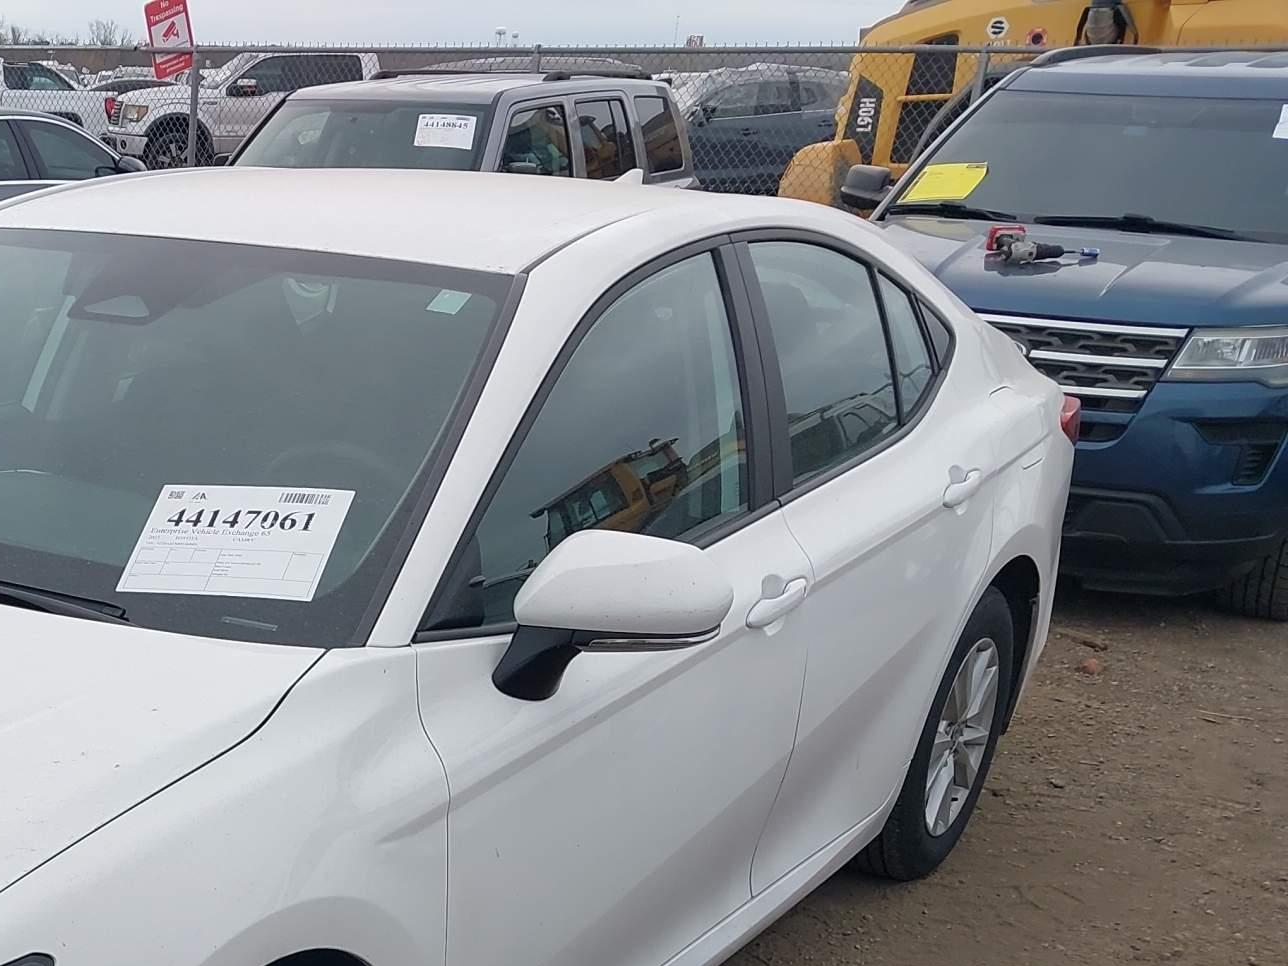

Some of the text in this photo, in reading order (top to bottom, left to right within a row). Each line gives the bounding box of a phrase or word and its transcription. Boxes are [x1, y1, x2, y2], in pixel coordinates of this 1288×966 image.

[150, 4, 184, 23] Trespassing
[856, 97, 877, 132] L90H
[167, 509, 316, 531] 44147061
[150, 527, 189, 536] Enterprise
[192, 528, 219, 536] Vehicle
[221, 528, 260, 538] Exchange
